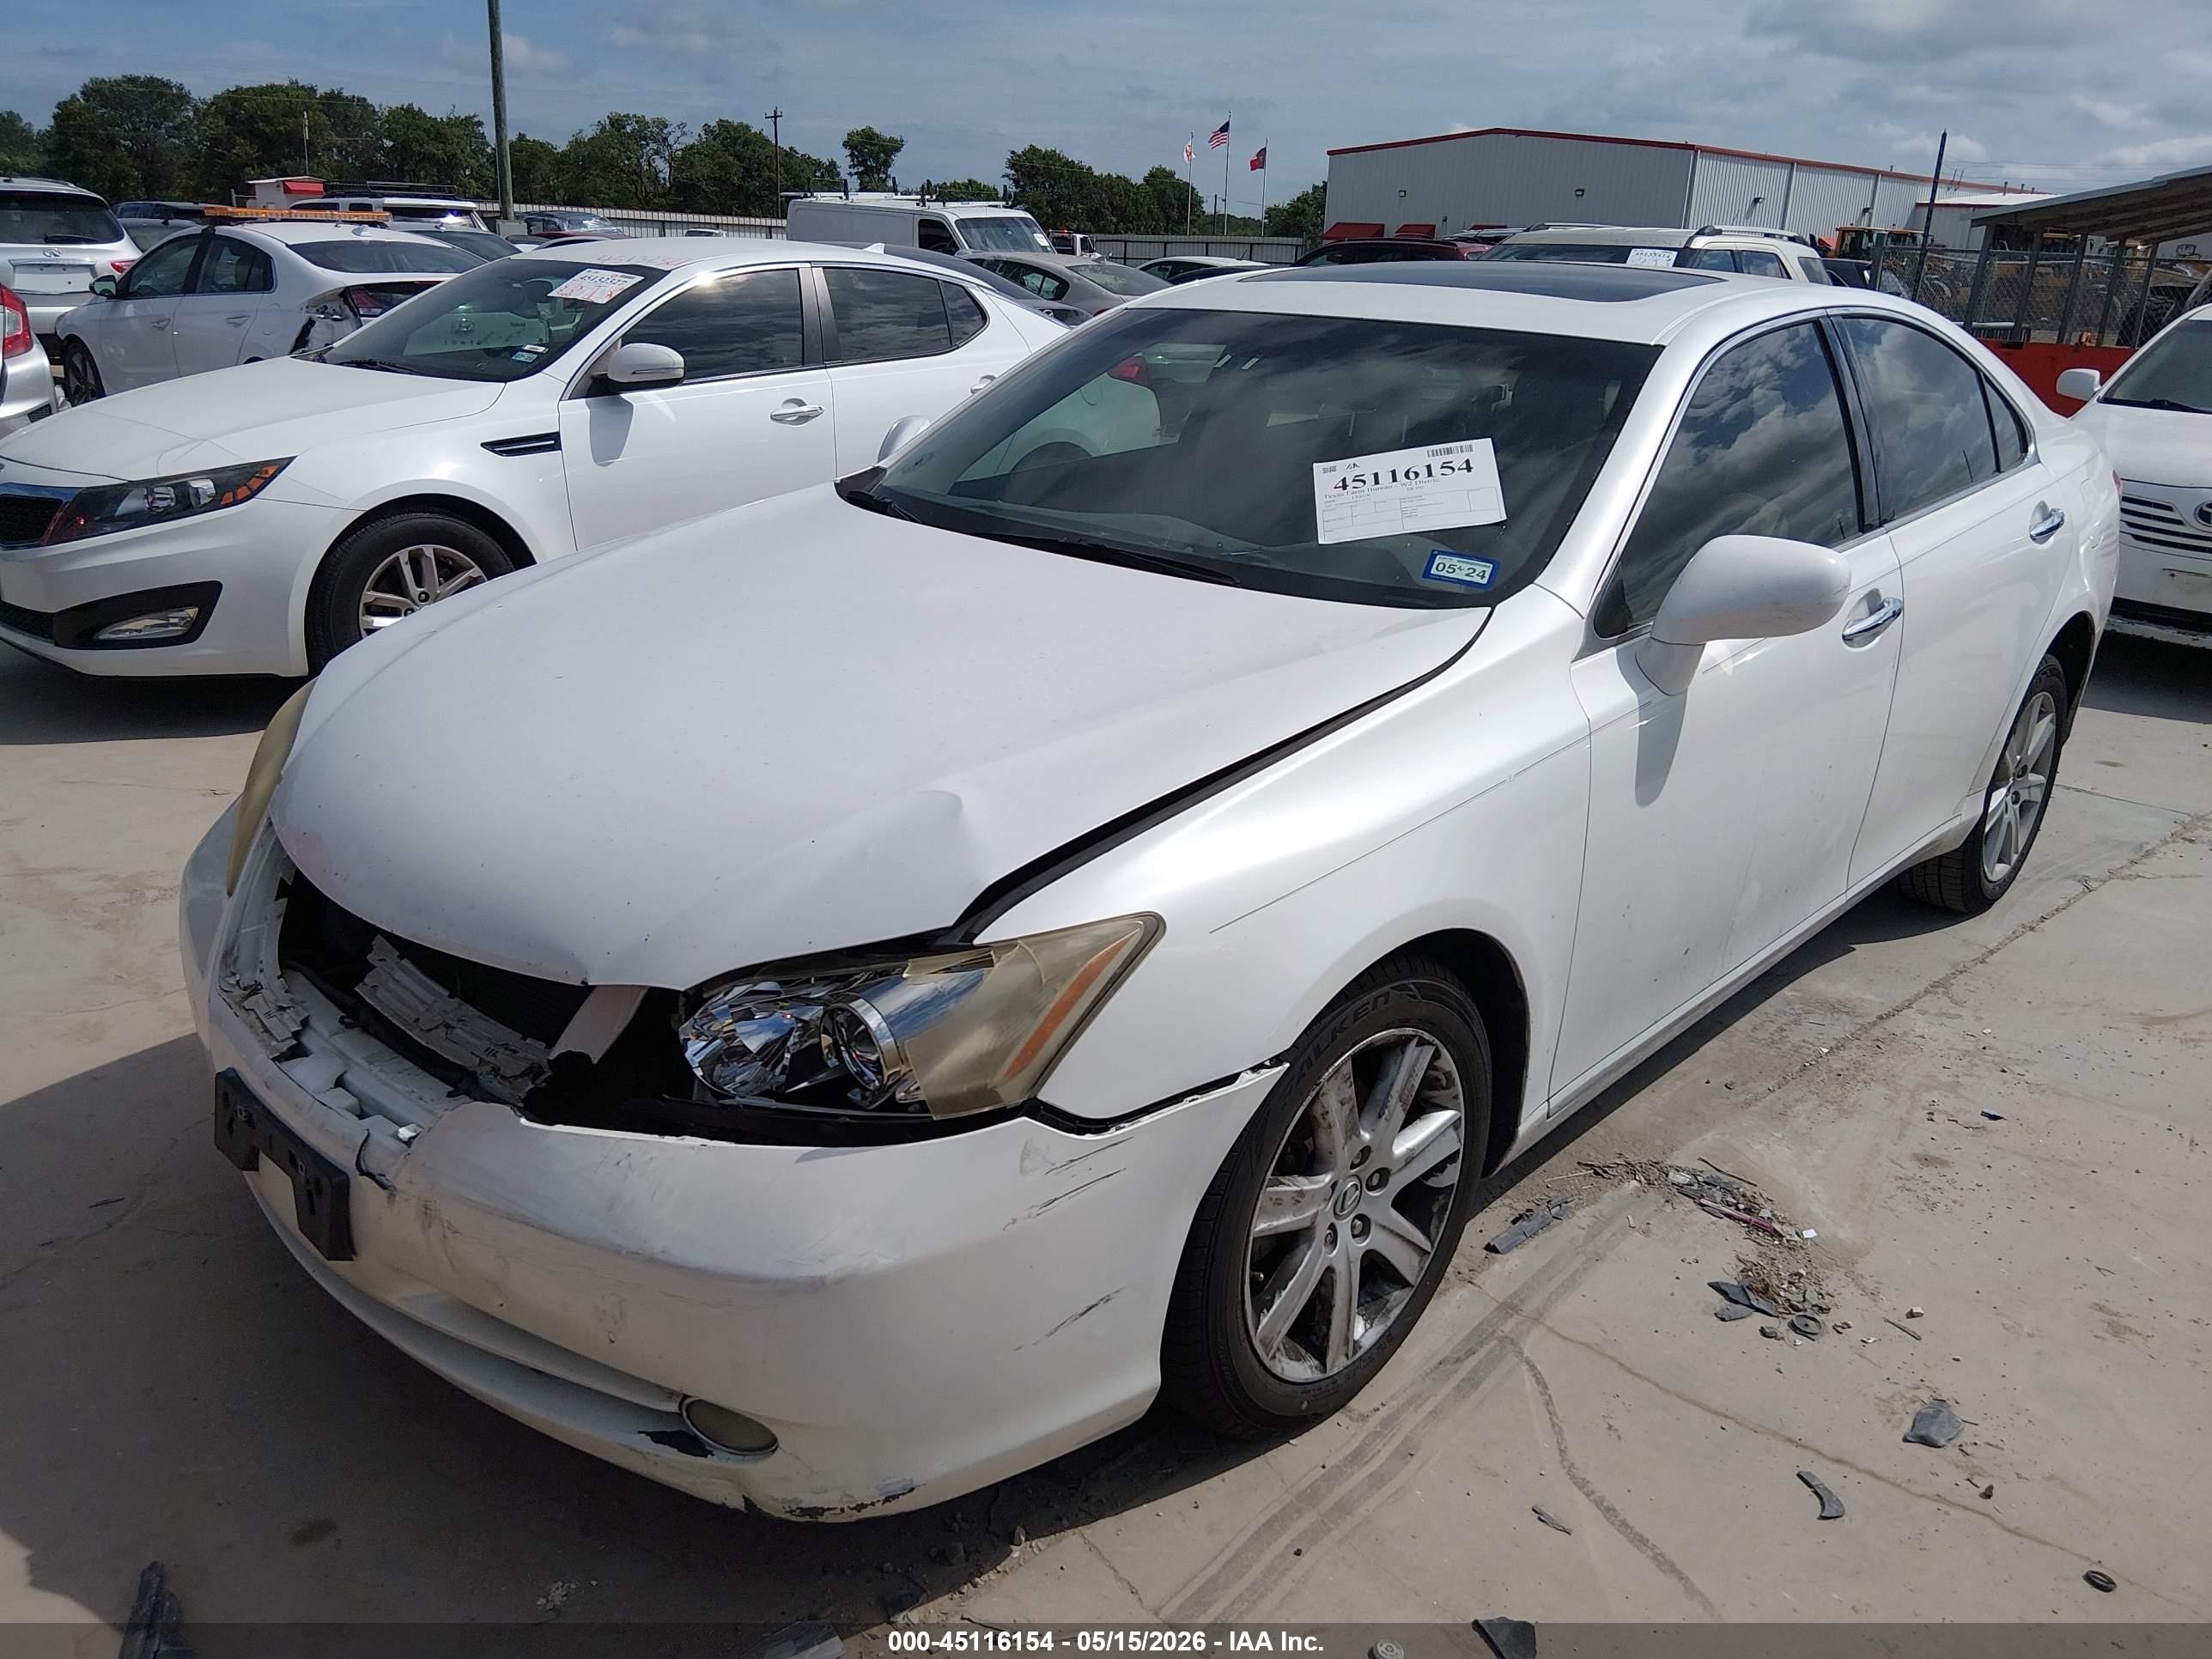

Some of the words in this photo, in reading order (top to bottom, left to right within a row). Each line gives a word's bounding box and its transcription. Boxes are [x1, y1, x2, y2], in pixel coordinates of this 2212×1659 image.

[1333, 458, 1474, 491] 45116154
[1367, 484, 1394, 494] Bureau
[1435, 562, 1458, 574] 05
[1465, 567, 1487, 580] 24
